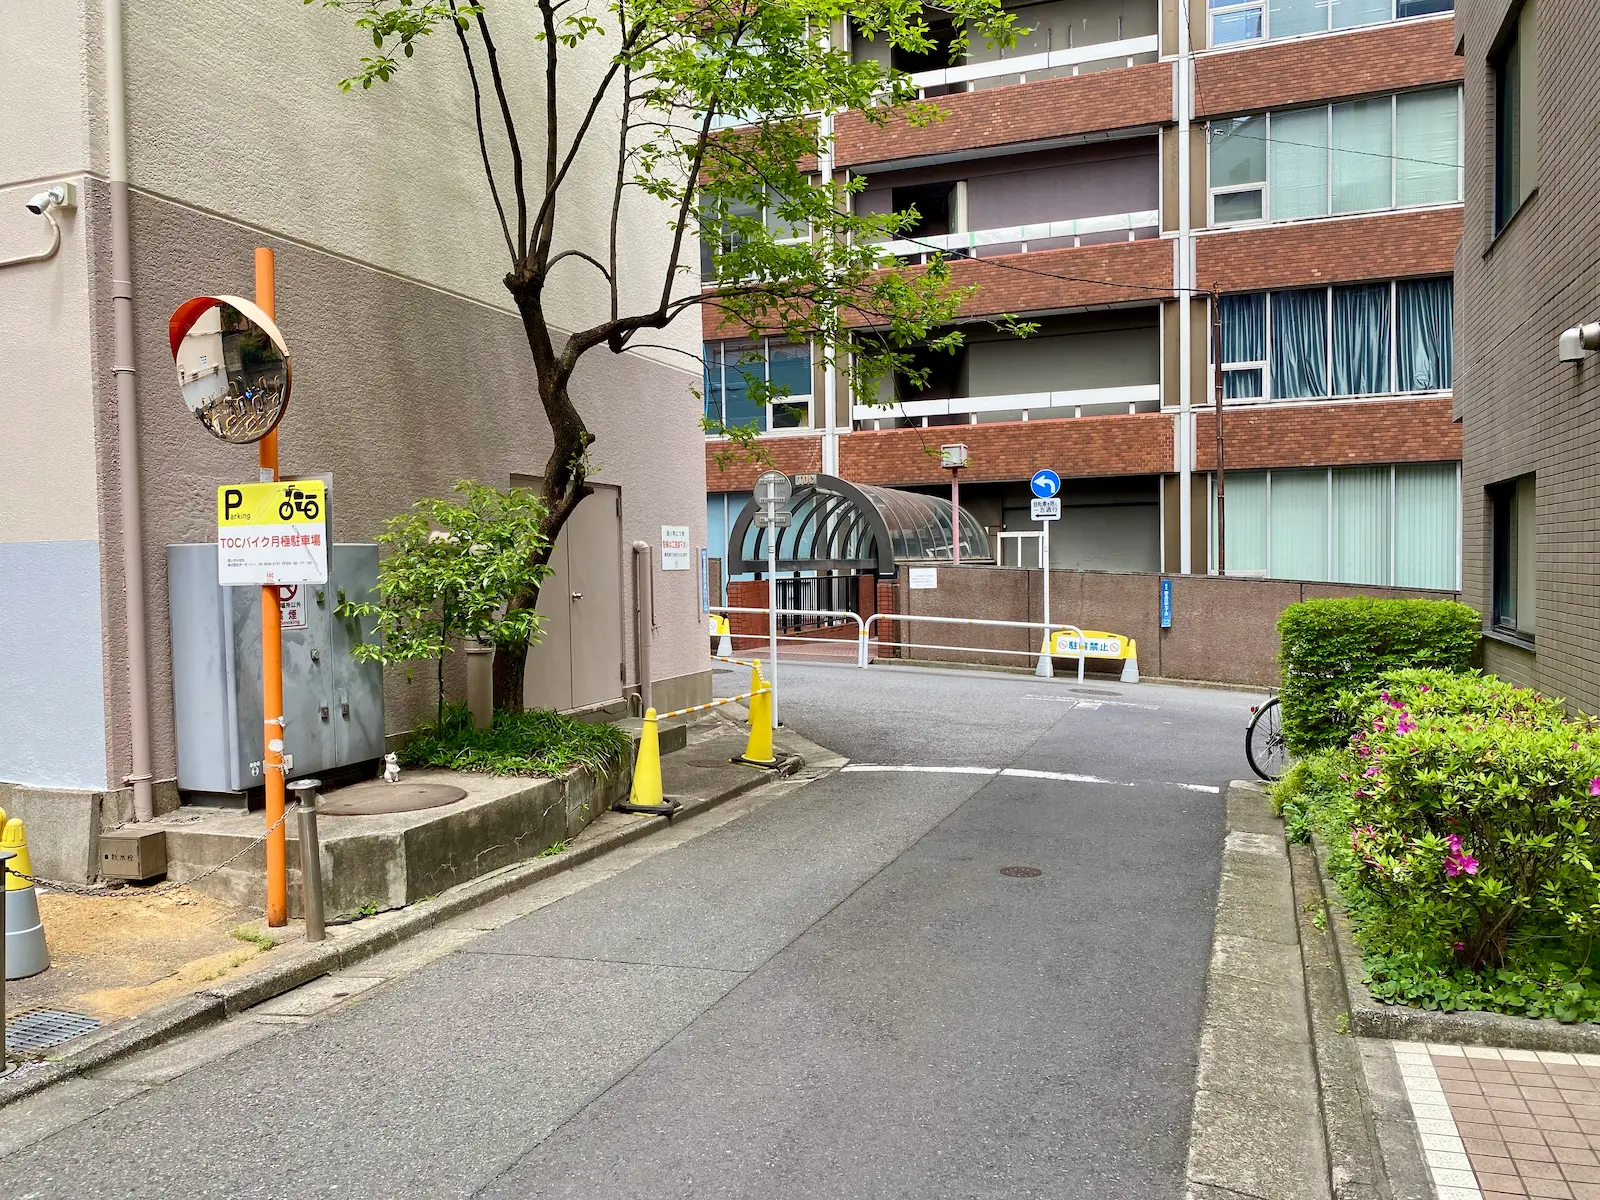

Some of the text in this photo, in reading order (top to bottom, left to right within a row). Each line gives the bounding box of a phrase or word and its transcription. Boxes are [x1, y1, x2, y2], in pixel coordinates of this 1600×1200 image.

[220, 534, 321, 549] TOCバイク月極駐車場
